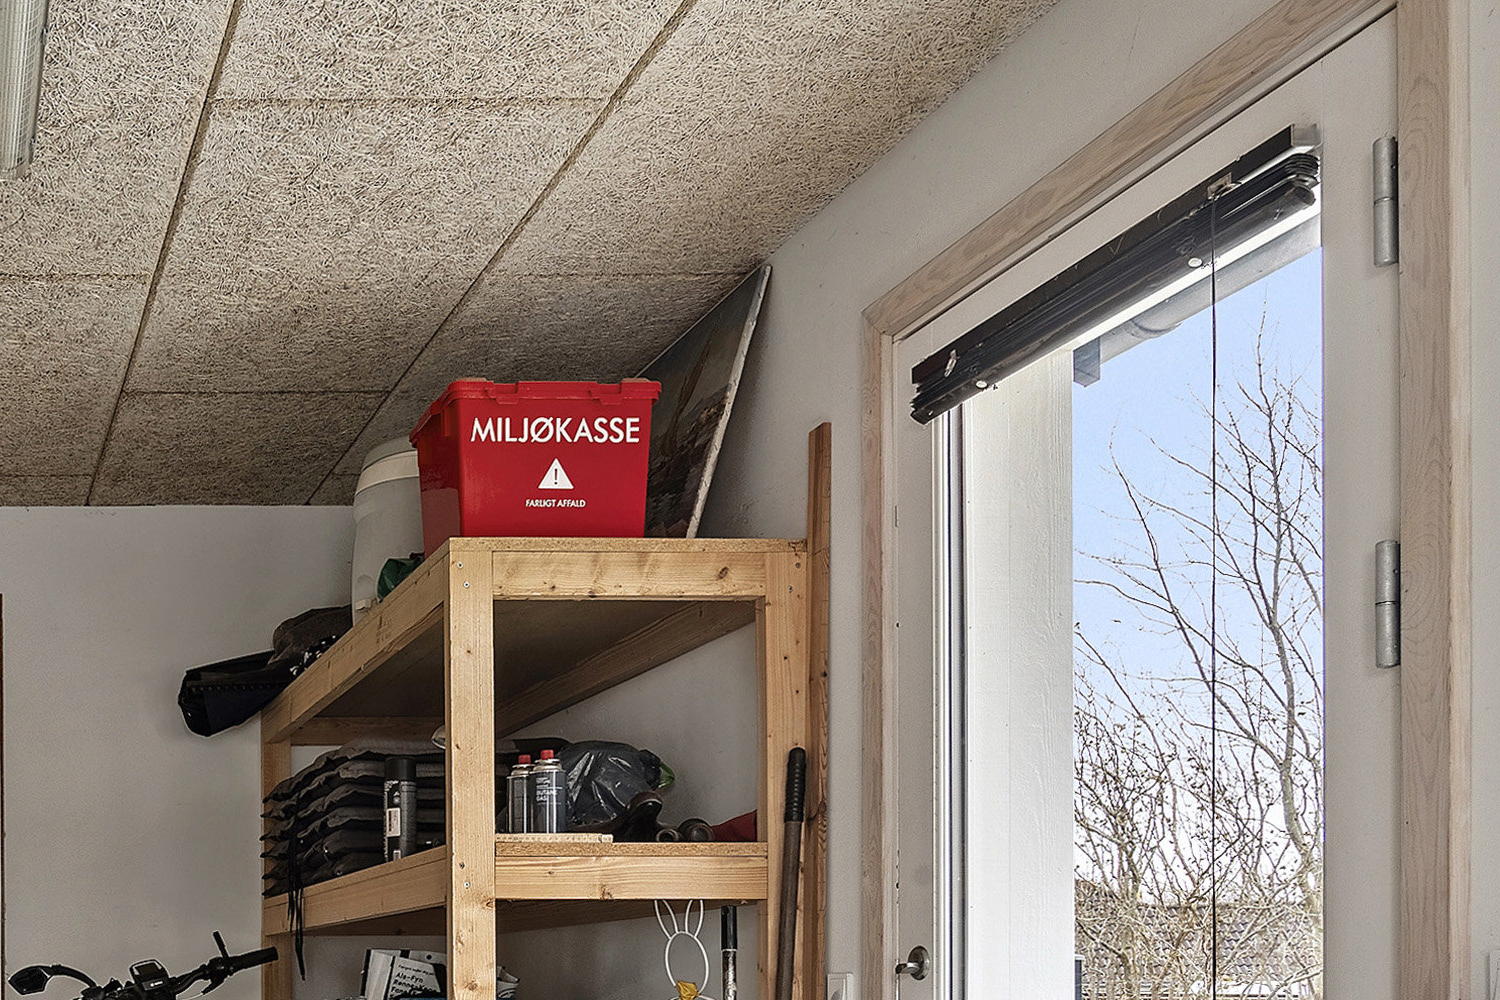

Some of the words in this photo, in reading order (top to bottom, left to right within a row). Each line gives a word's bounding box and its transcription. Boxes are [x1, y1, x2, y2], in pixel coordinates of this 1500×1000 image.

[470, 416, 640, 443] MILJØKASSE
[525, 499, 556, 508] FARLIGT
[557, 499, 587, 508] AFFALD
